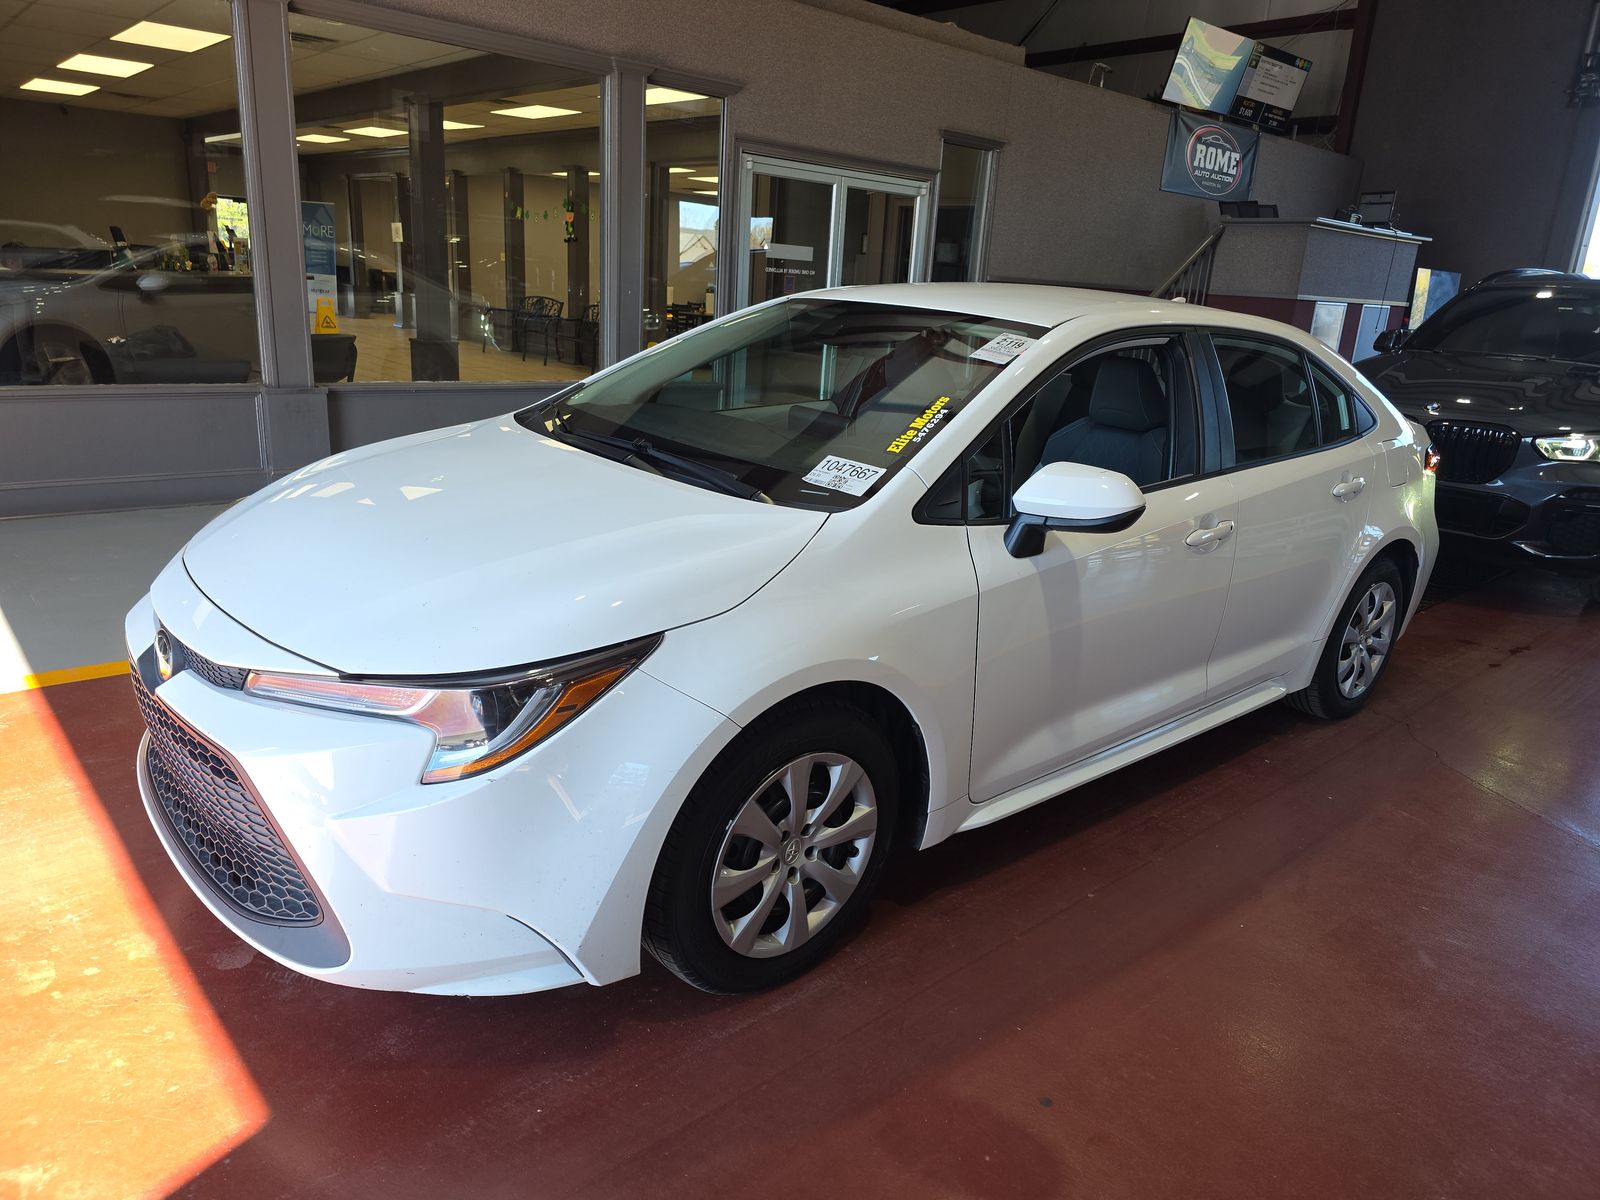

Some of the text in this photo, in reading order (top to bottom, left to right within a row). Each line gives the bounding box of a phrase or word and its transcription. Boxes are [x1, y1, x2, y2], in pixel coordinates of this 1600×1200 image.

[1193, 143, 1240, 175] ROME
[1194, 169, 1234, 183] AUTO AUCTION
[303, 224, 335, 239] MORE
[886, 396, 950, 454] Elite Motors
[912, 408, 949, 443] 5476294
[821, 459, 879, 481] 1047667
